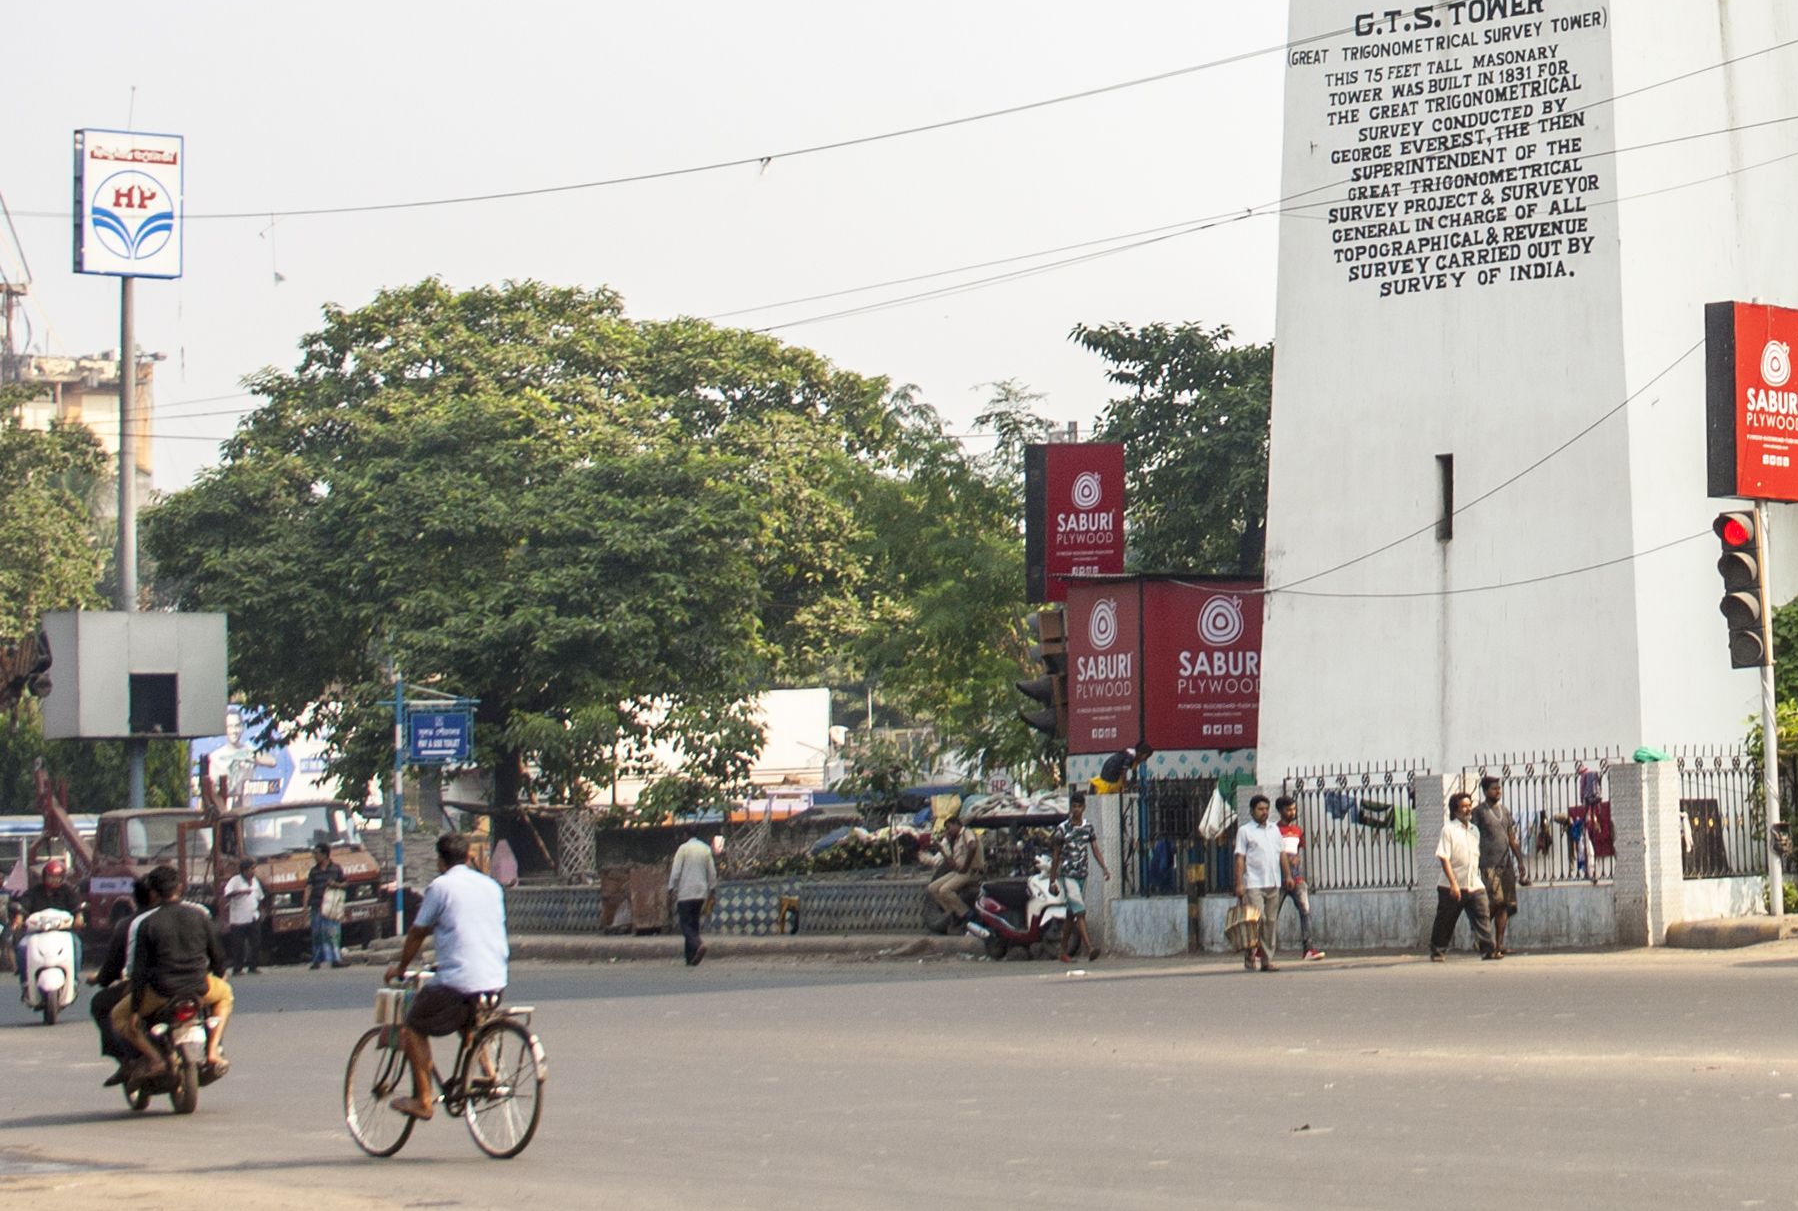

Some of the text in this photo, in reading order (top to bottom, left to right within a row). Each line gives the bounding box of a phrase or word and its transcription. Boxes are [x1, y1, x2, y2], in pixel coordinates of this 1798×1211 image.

[1287, 6, 1607, 67] (GREAT TRIGONOMETRICAL SURVEY TOWER)
[1355, 5, 1441, 36] G.T.S.
[1325, 44, 1559, 87] THIS 75 FEET TALL MASONARY
[1329, 60, 1570, 106] TOWER WAS BUILT IN 1831 FOR
[1327, 74, 1581, 126] THE GREAT TRIGONOMETRICAL
[1358, 97, 1567, 142] SURVEY CONDUCTED BY
[1331, 111, 1585, 164] GEORGE EVEREST, THE THEN
[1351, 137, 1582, 182] SUPERINTENDENT OF THE
[112, 184, 156, 209] HP
[1328, 174, 1599, 224] SURVEY PROJECT & SURVEYOR
[1348, 158, 1582, 201] GREAT TRIGONOMETRICAL
[1332, 197, 1586, 243] GENERAL IN CHARGE OF ALL
[1334, 218, 1588, 263] TOPOGRAPHICAL & REVENUE
[1349, 235, 1595, 282] SURVEY CARRIED OUT BY
[1380, 260, 1575, 298] SURVEY OF INDIA.
[1056, 532, 1114, 545] PLYWOOD
[1057, 512, 1113, 532] SABURI
[1077, 653, 1132, 681] SABURI
[1179, 650, 1259, 677] SABUR
[1076, 681, 1132, 699] PLYWOOD
